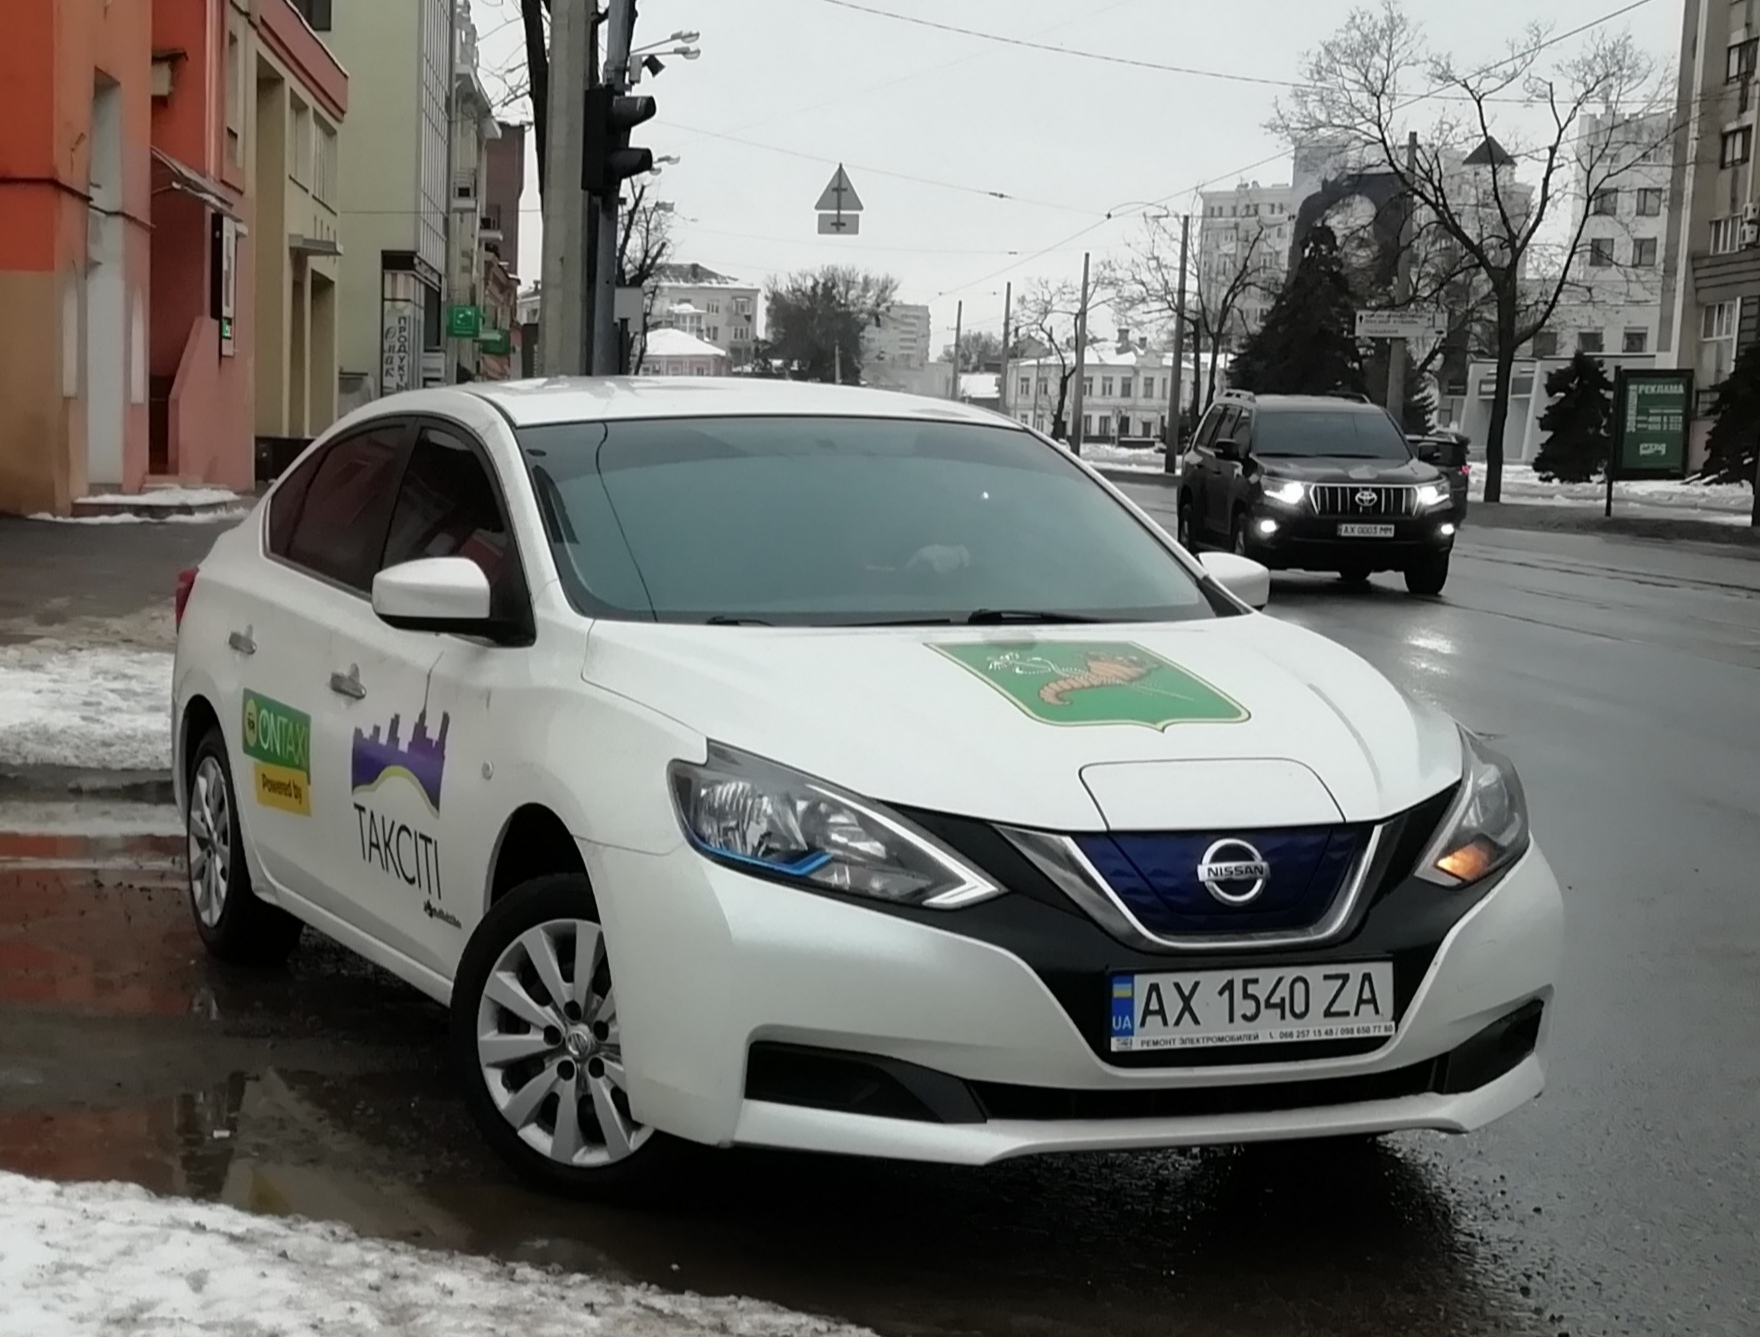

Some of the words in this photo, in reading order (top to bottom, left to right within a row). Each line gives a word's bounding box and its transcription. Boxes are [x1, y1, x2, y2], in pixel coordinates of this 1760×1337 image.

[261, 772, 292, 799] Powered
[292, 779, 303, 805] by
[1207, 865, 1264, 878] NISSAN
[1139, 980, 1201, 1028] AX
[1217, 975, 1310, 1024] 1540
[1322, 972, 1381, 1018] ZA
[1112, 1015, 1132, 1031] UA
[1140, 1038, 1177, 1048] РЕМОНТ
[1179, 1032, 1259, 1046] ЭЛЕКТРОМОБИЛЕЙ
[1296, 1029, 1310, 1039] 257
